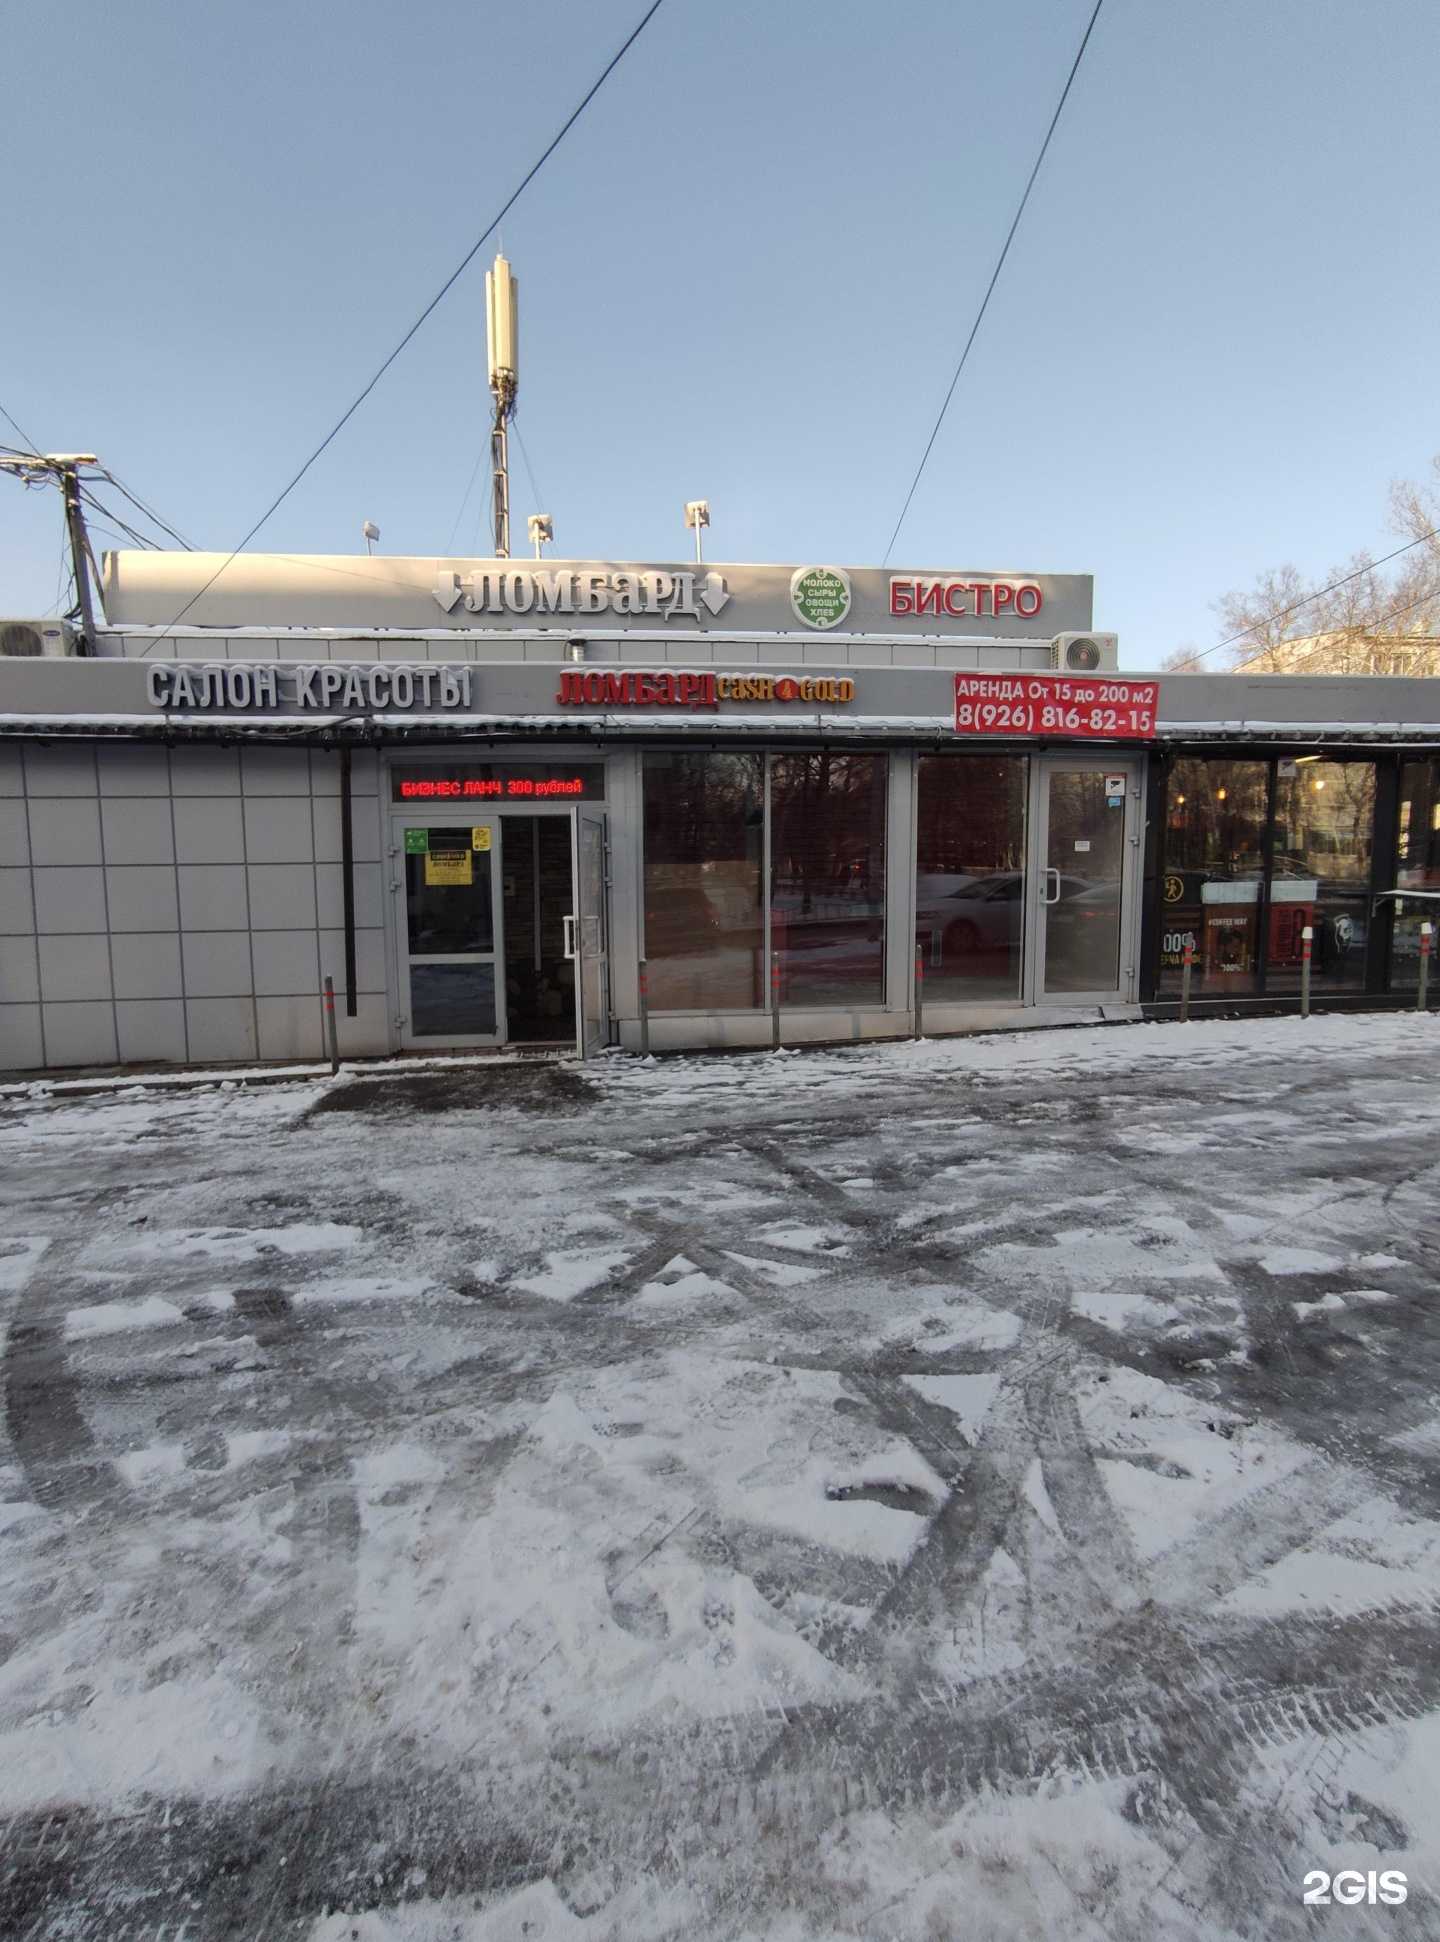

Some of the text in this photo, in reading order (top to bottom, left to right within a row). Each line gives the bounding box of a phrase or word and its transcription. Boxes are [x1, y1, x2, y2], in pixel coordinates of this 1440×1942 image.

[803, 579, 841, 588] МОЛОКО
[808, 589, 837, 597] СЫРЫ
[805, 599, 840, 608] ОВОЩИ
[890, 578, 1043, 618] БИСТРО
[810, 608, 835, 617] ХЛЕБ
[147, 665, 472, 709] САЛОН КРАСОТЫ
[957, 679, 1155, 704] АРЕНДА От 15 до 200 м2
[958, 703, 1152, 732] 8(926) 816-82-15
[402, 777, 583, 797] БИЗНЕС ЛАНЧ 300 рублей
